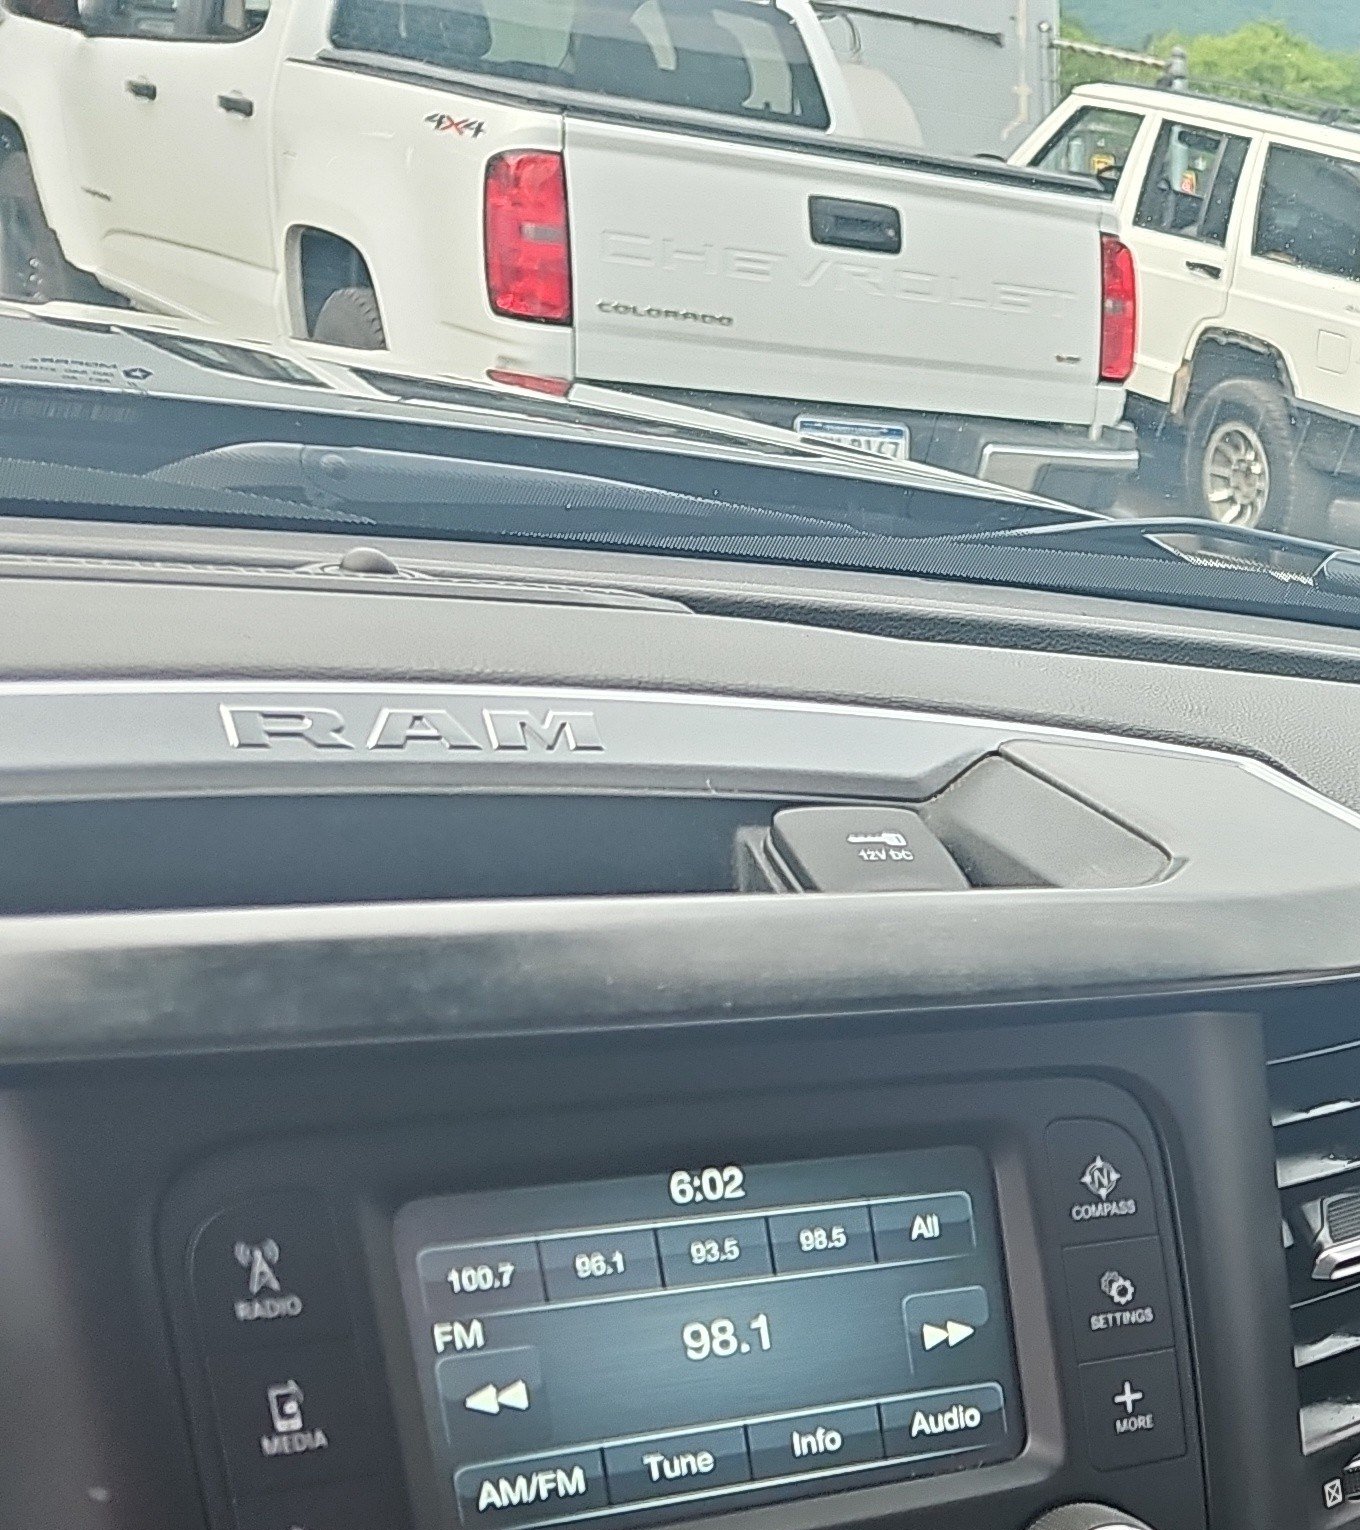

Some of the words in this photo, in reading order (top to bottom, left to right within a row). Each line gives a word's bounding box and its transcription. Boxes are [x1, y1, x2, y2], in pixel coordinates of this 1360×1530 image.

[596, 299, 734, 327] COLORADO
[219, 702, 606, 752] RAM
[858, 847, 888, 862] 12V
[889, 848, 914, 862] DC
[670, 1165, 745, 1205] 6:02
[1071, 1199, 1137, 1222] COMPASS
[447, 1262, 515, 1293] 100.7
[574, 1251, 625, 1279] 96.1
[690, 1237, 740, 1264] 93.5
[800, 1225, 847, 1251] 98.5
[910, 1213, 941, 1241] All
[234, 1295, 303, 1321] RADIO
[1090, 1306, 1154, 1331] SETTINGS
[433, 1318, 485, 1353] FM
[682, 1313, 772, 1361] 98.1
[1115, 1413, 1154, 1434] MORE
[260, 1428, 329, 1456] MEDIA
[478, 1465, 587, 1512] AM/FM
[643, 1450, 715, 1482] Tune
[791, 1426, 843, 1457] Info
[910, 1404, 981, 1438] Audio
